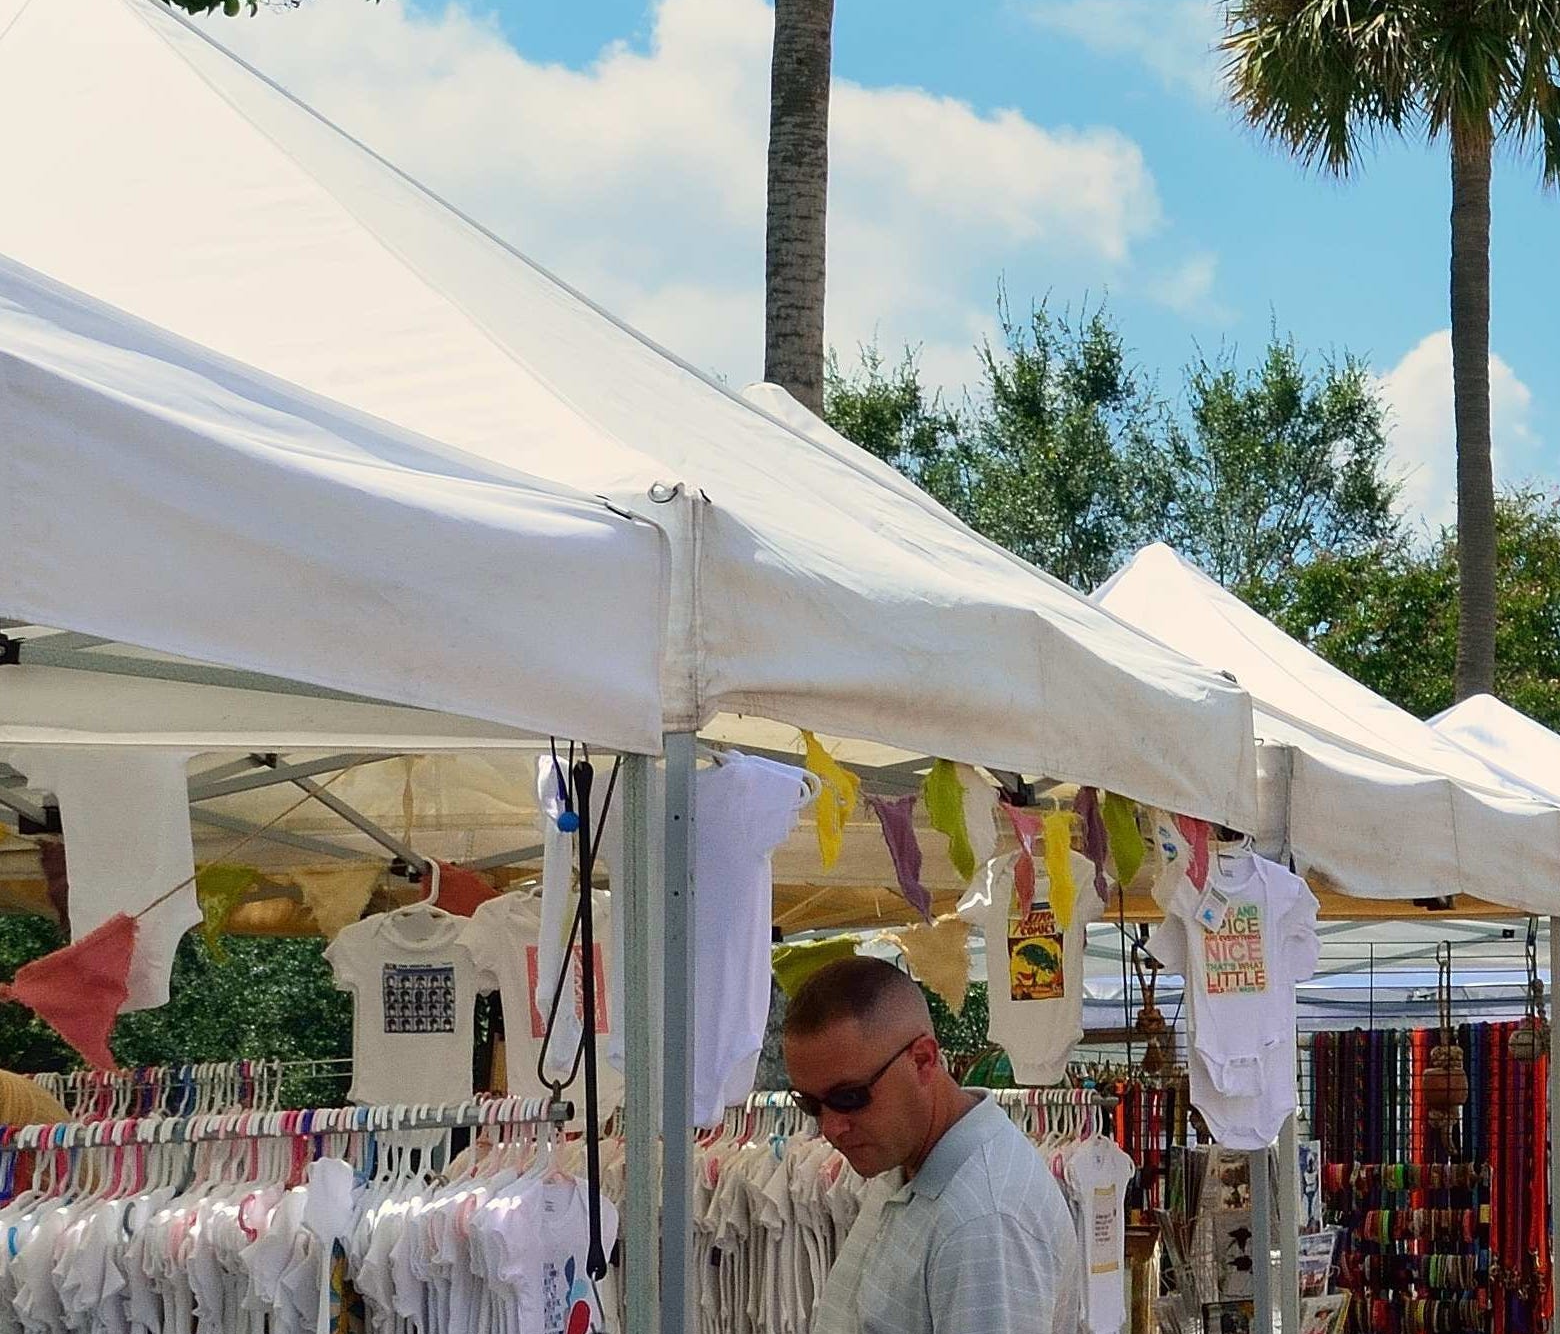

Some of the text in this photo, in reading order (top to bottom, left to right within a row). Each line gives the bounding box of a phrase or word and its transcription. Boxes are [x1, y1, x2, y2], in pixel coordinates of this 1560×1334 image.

[1237, 905, 1258, 917] AND
[1205, 940, 1262, 962] NICE
[1206, 970, 1266, 988] LITTLE
